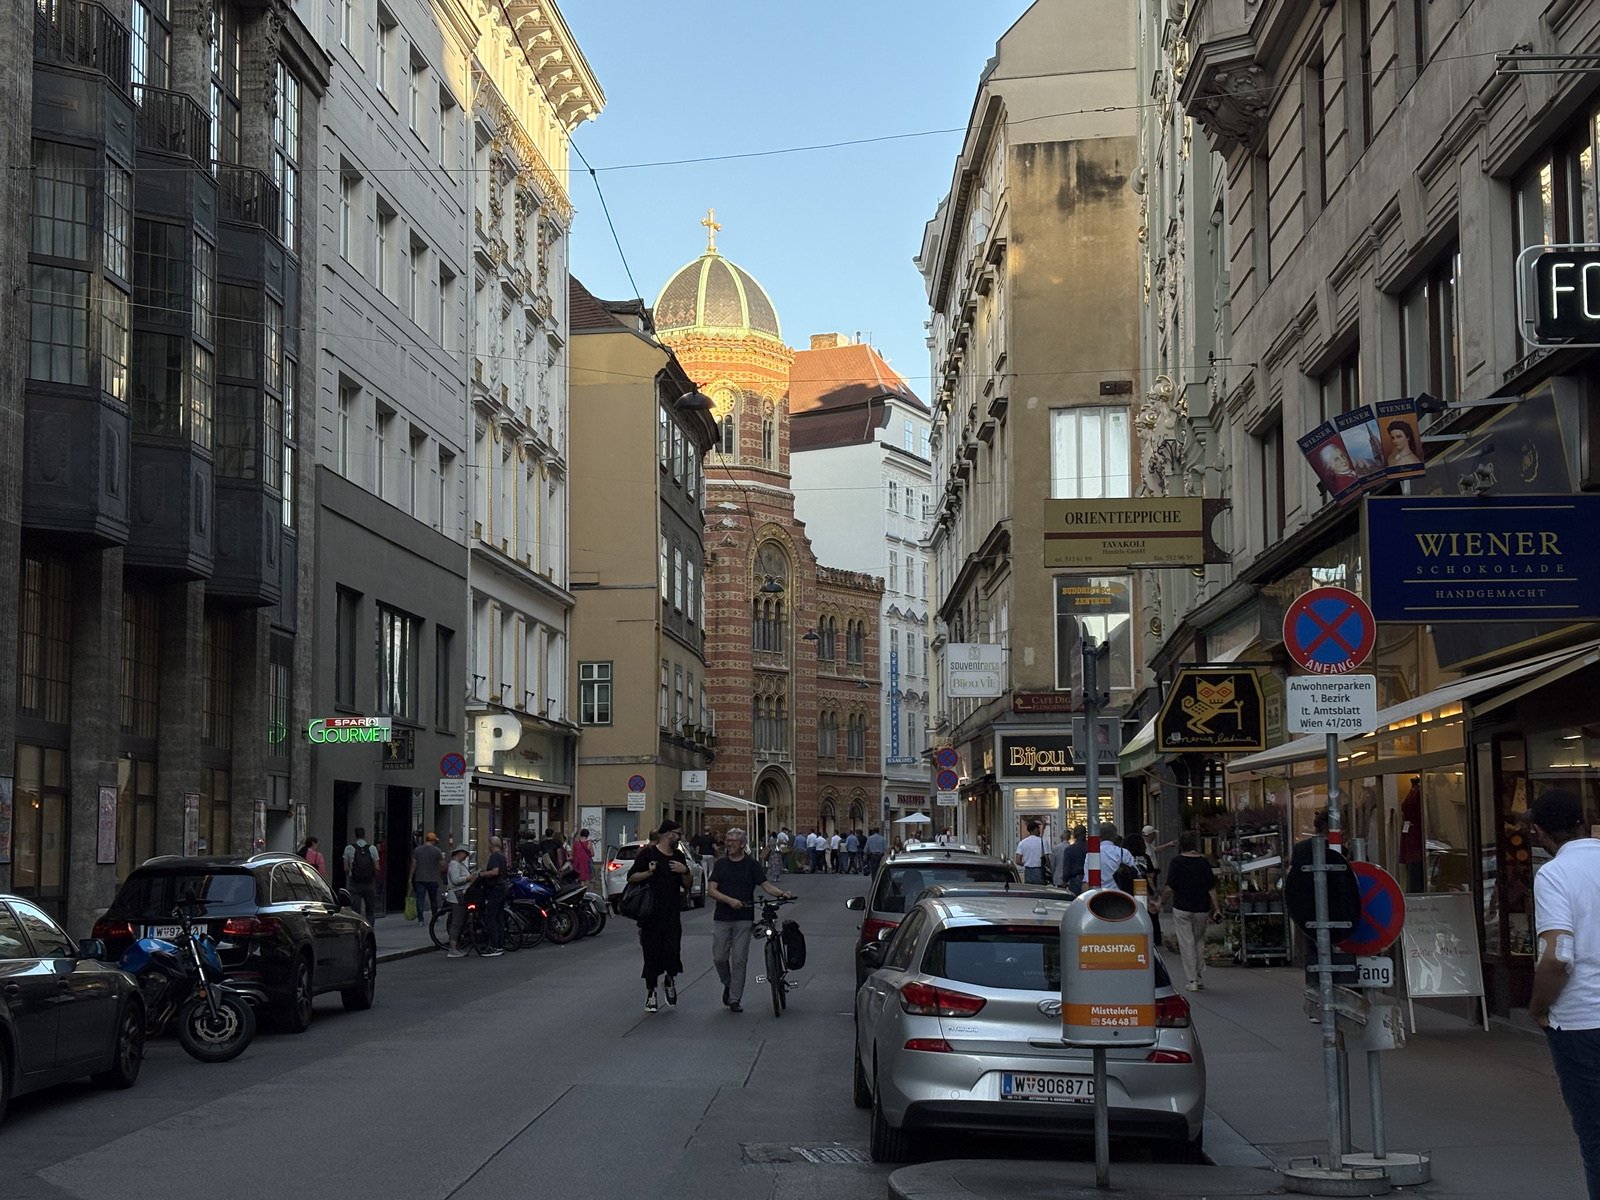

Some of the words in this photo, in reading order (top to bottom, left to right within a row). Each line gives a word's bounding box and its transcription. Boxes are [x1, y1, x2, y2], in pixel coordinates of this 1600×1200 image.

[1378, 403, 1412, 413] WIENER
[1338, 410, 1371, 427] WIENER
[1301, 427, 1332, 449] WIENER
[1064, 510, 1182, 525] ORIENTTEPPICHE
[1102, 540, 1146, 548] TAVAKOLI
[1415, 531, 1563, 557] WIENER
[1416, 564, 1565, 575] SCHOKOLADE
[1435, 589, 1546, 599] HANDGEMACHT
[1075, 597, 1112, 606] ZENTRUM
[1305, 658, 1355, 674] ANFANG
[953, 678, 978, 689] Bijou
[1290, 682, 1371, 692] Anwohnerparken
[1310, 694, 1318, 703] 1.
[1321, 694, 1351, 703] Bezirk
[1301, 706, 1310, 716] lt.
[1313, 706, 1360, 715] Amtsblatt
[1300, 719, 1323, 728] Wien
[1325, 717, 1362, 729] 41/2018
[475, 714, 522, 766] P
[1009, 746, 1066, 771] Bijou
[1081, 944, 1136, 953] #TRASHTAG
[1357, 964, 1389, 982] fang
[1091, 1007, 1138, 1015] Misttelefon
[1101, 1018, 1117, 1026] 546
[1118, 1018, 1129, 1026] 48
[1014, 1077, 1026, 1092] W
[1037, 1078, 1083, 1095] 90687
